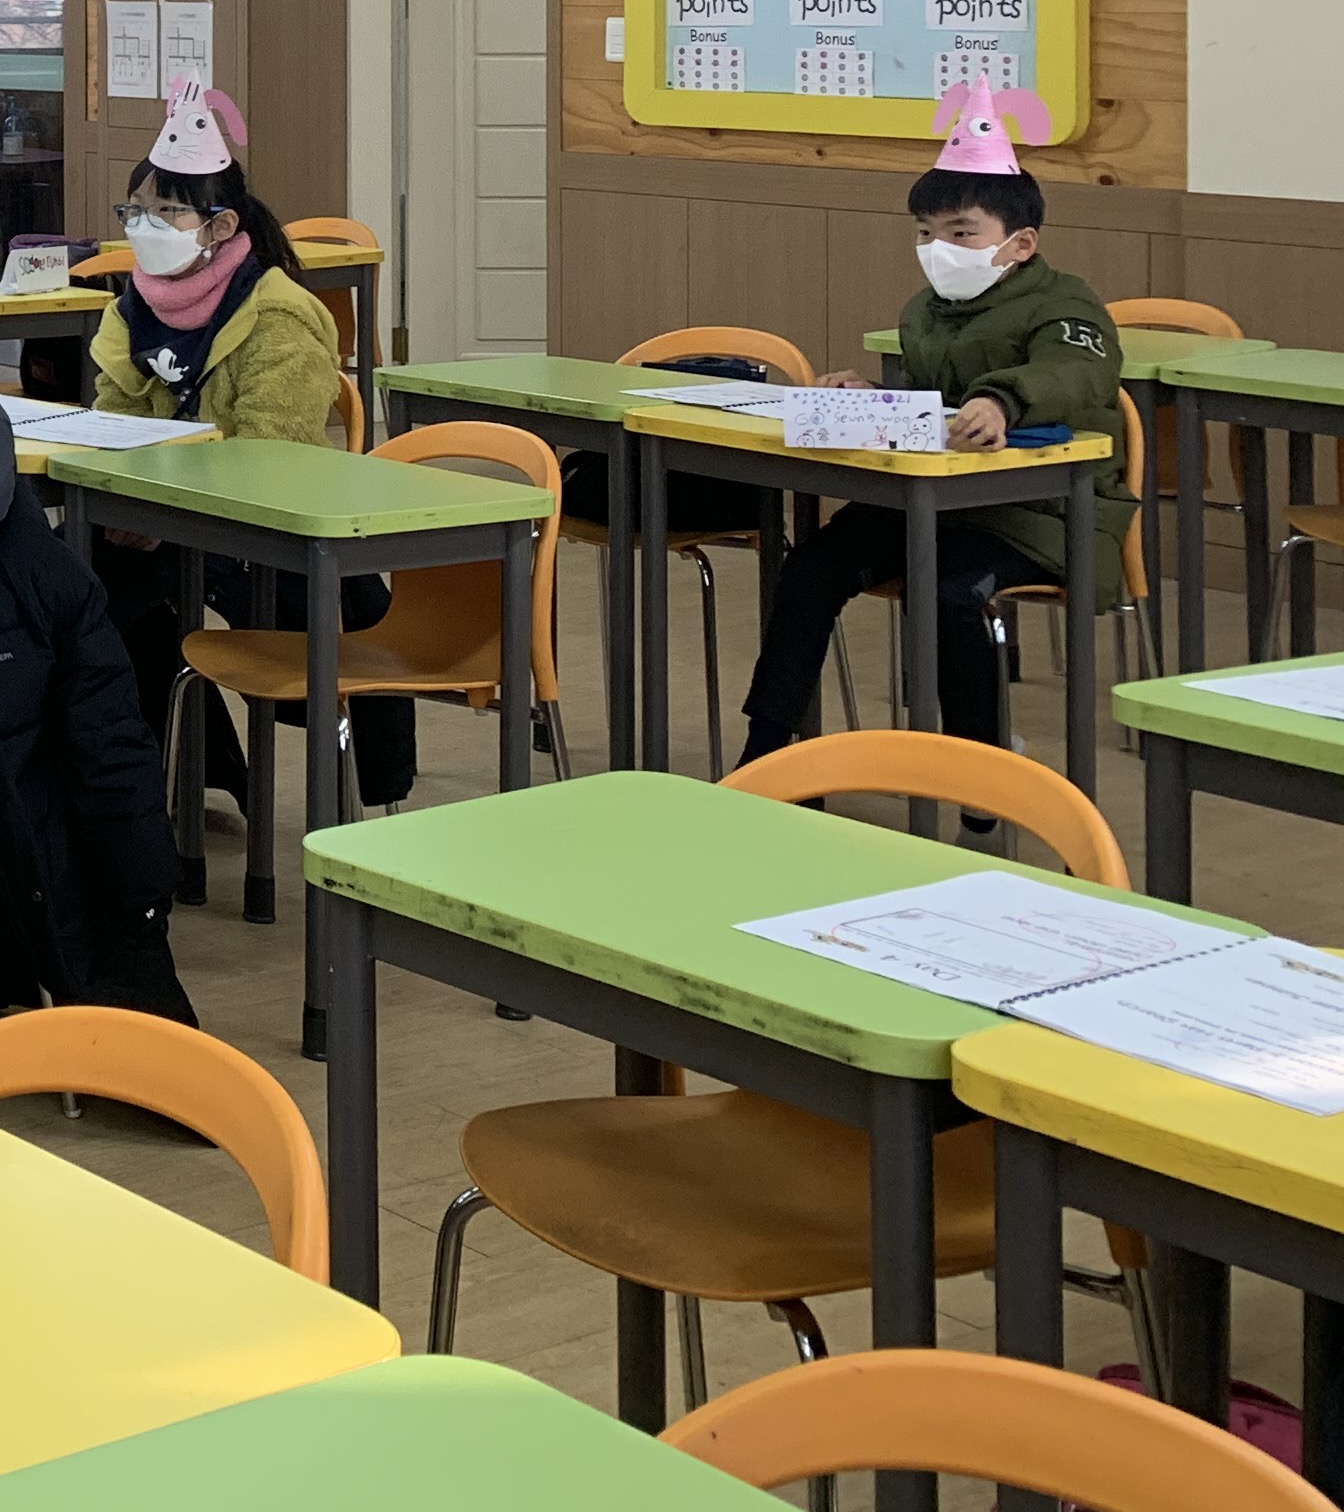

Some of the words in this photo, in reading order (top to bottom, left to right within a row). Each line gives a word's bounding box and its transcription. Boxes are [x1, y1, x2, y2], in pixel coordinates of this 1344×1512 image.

[690, 29, 727, 42] Bonus
[815, 32, 855, 46] Bonus
[955, 37, 999, 51] Bonus
